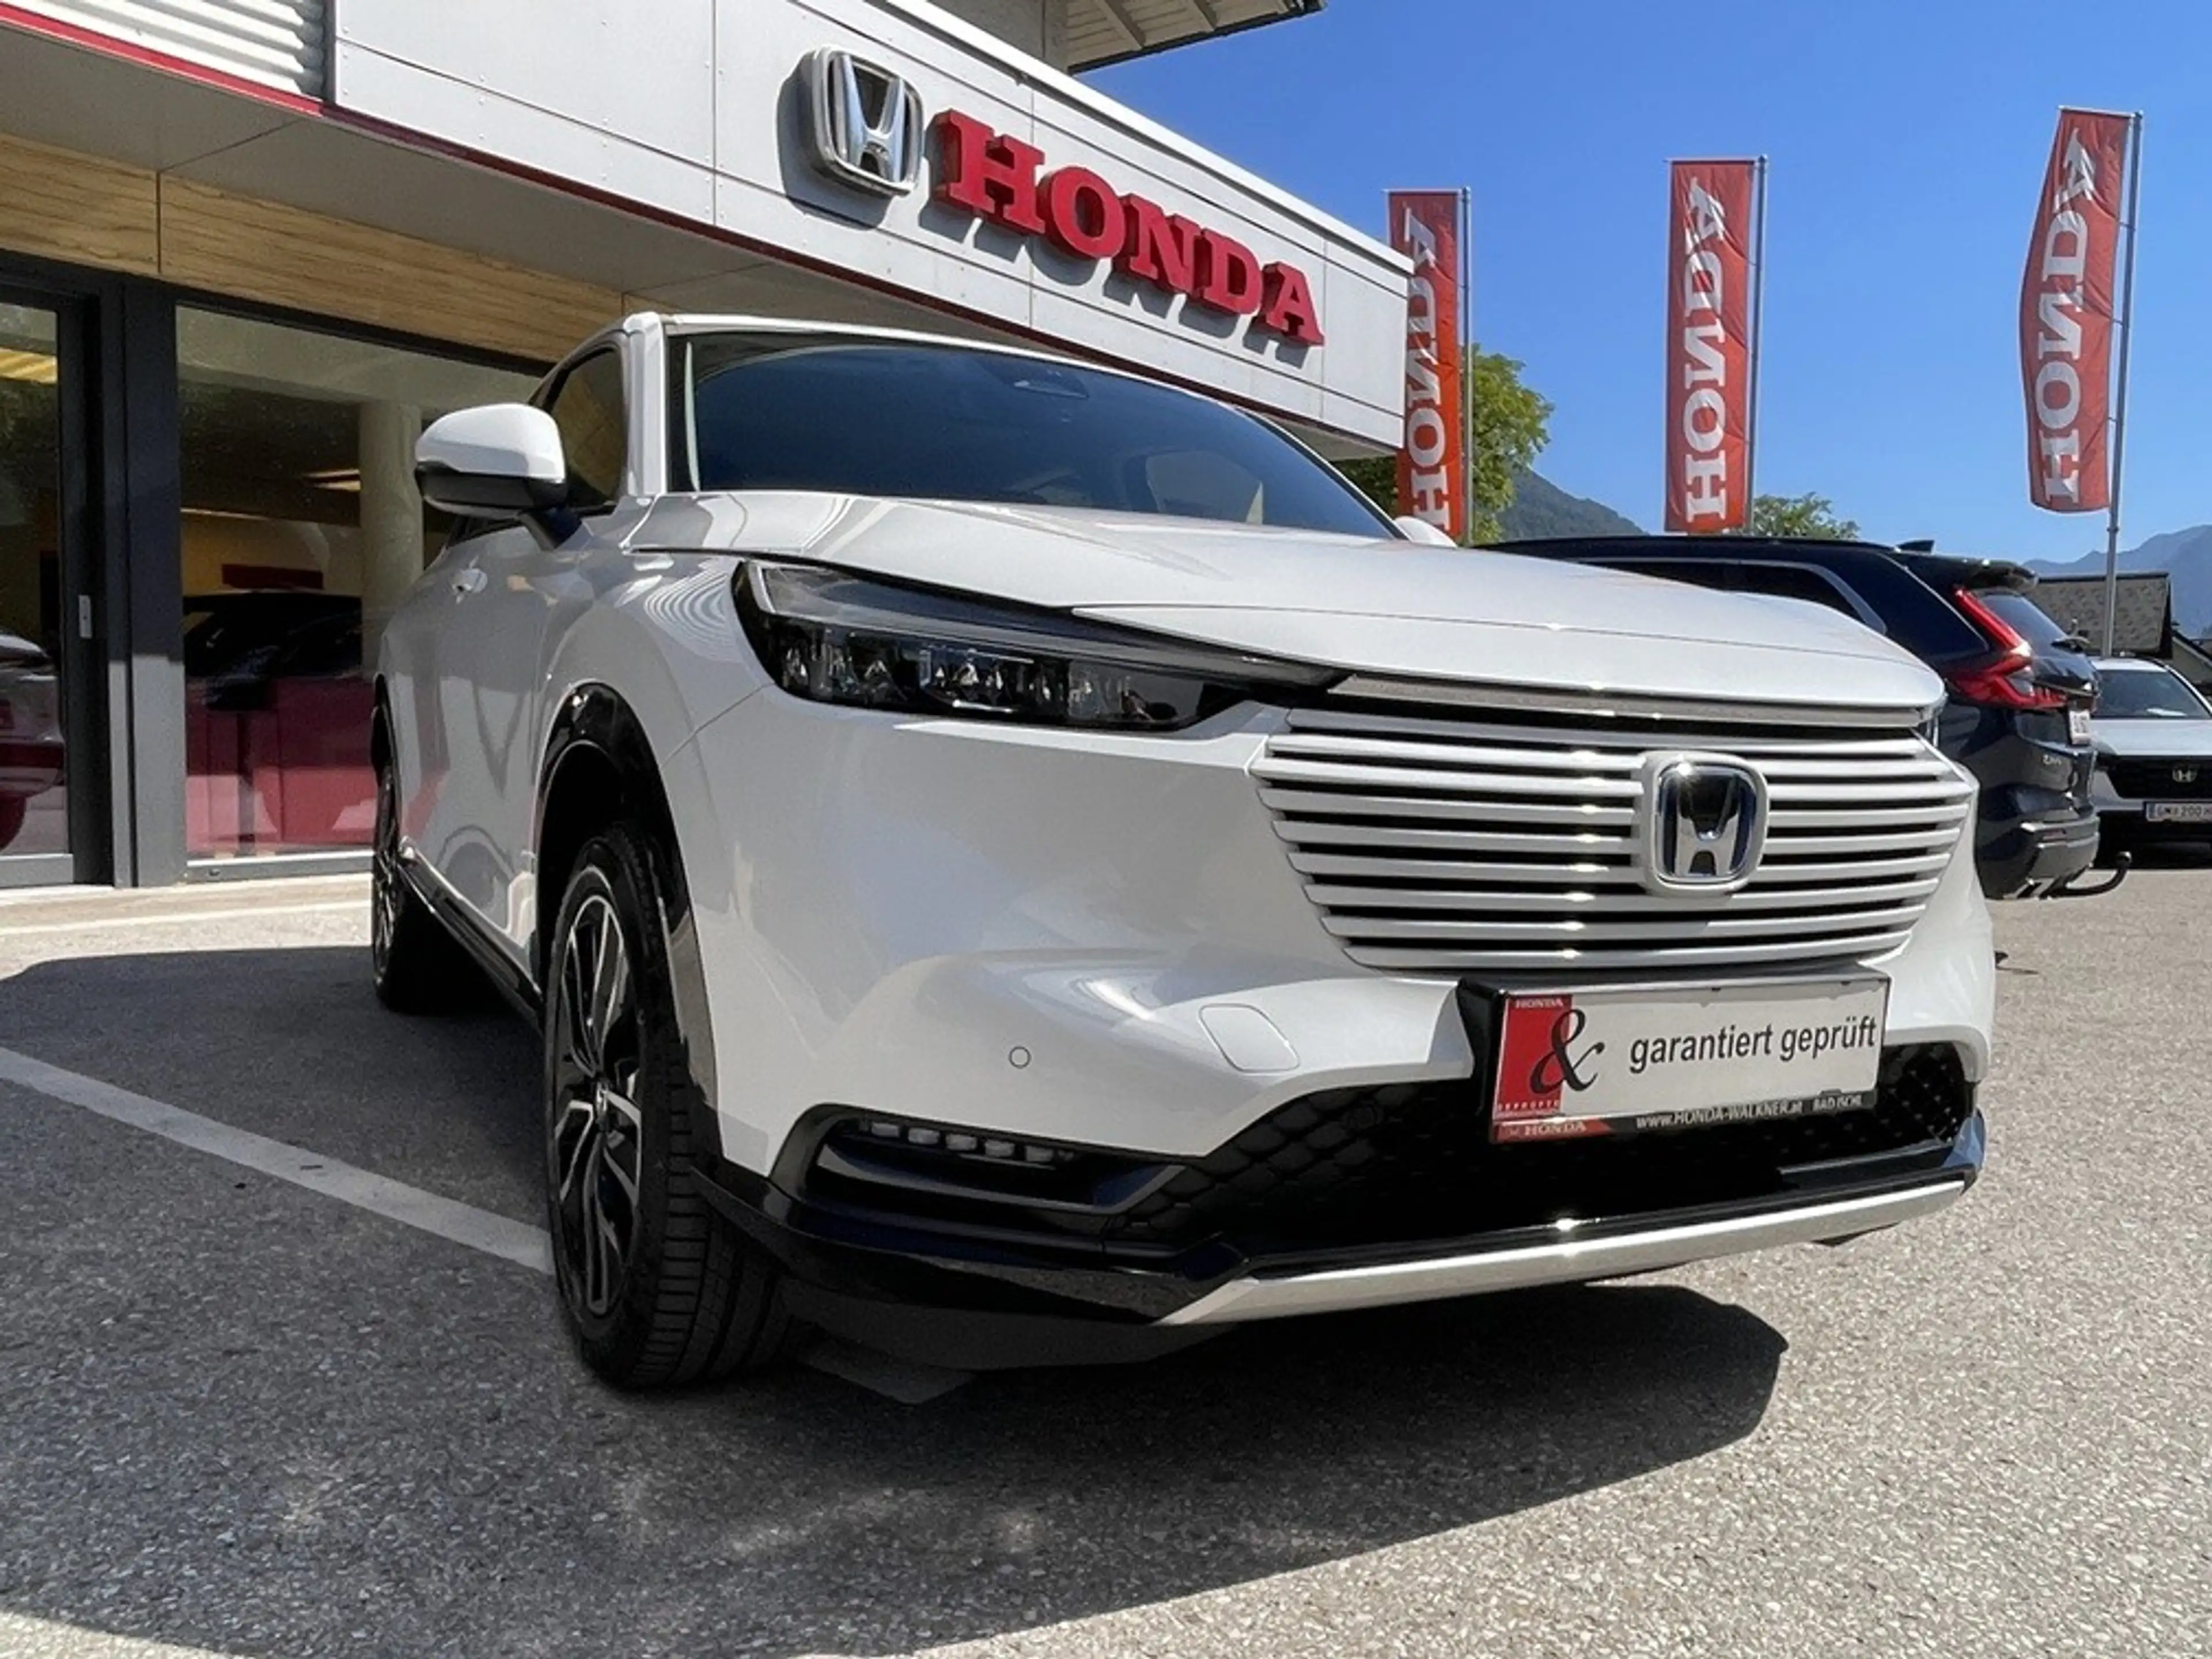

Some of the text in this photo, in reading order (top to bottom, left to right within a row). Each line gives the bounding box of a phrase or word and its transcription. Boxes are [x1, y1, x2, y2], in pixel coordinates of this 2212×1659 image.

[934, 108, 1324, 347] HONDA
[1630, 1016, 1877, 1074] garantiert geprüft
[1524, 1121, 1587, 1136] HONDA
